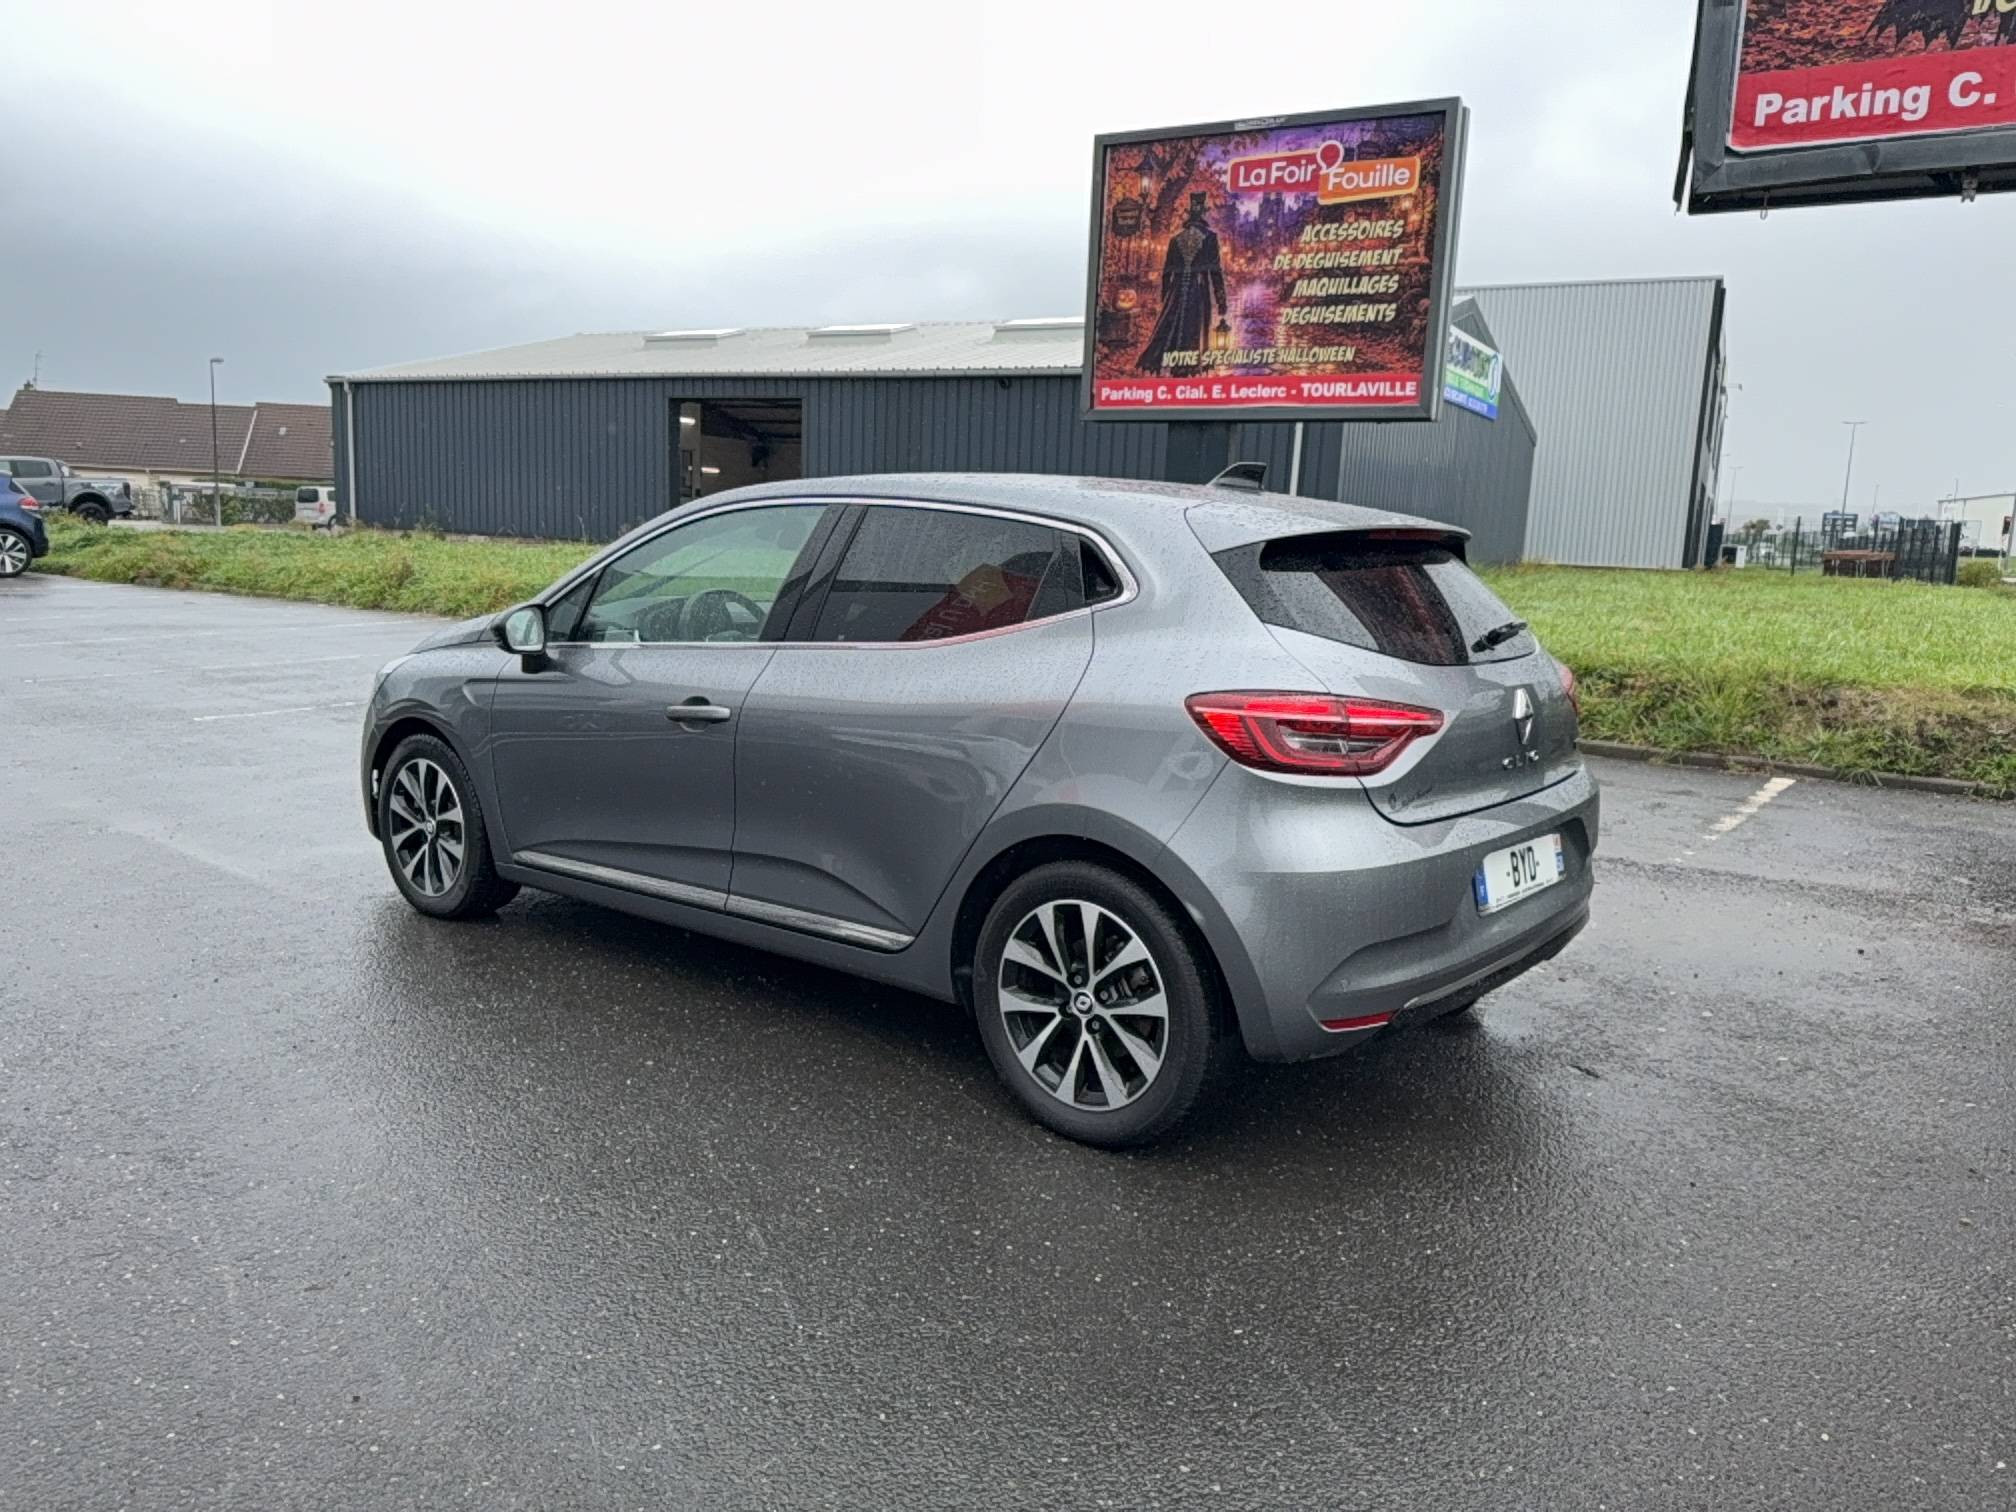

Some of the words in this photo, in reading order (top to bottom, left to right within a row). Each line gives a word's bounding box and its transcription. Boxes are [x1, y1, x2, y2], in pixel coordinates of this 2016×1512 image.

[1753, 82, 1931, 127] Parking
[1948, 71, 1997, 107] C.
[1238, 165, 1265, 188] La
[1327, 163, 1411, 192] Fouille
[1300, 219, 1405, 243] ACCESSOIRES
[1273, 253, 1293, 271] DE
[1295, 247, 1403, 270] DEGUISEMENT
[1291, 273, 1400, 298] MAQUILLAGES
[1281, 302, 1398, 326] DEGUISEMENTS
[1162, 350, 1199, 368] VOTRE
[1201, 347, 1276, 366] SPECIALISTE
[1278, 345, 1356, 364] HALLOWEEN
[1101, 386, 1153, 403] Parking
[1157, 385, 1172, 400] C.
[1175, 384, 1208, 400] Cial.
[1212, 384, 1227, 399] E.
[1230, 383, 1287, 398] Leclerc
[1300, 381, 1417, 398] TOURLAVILLE
